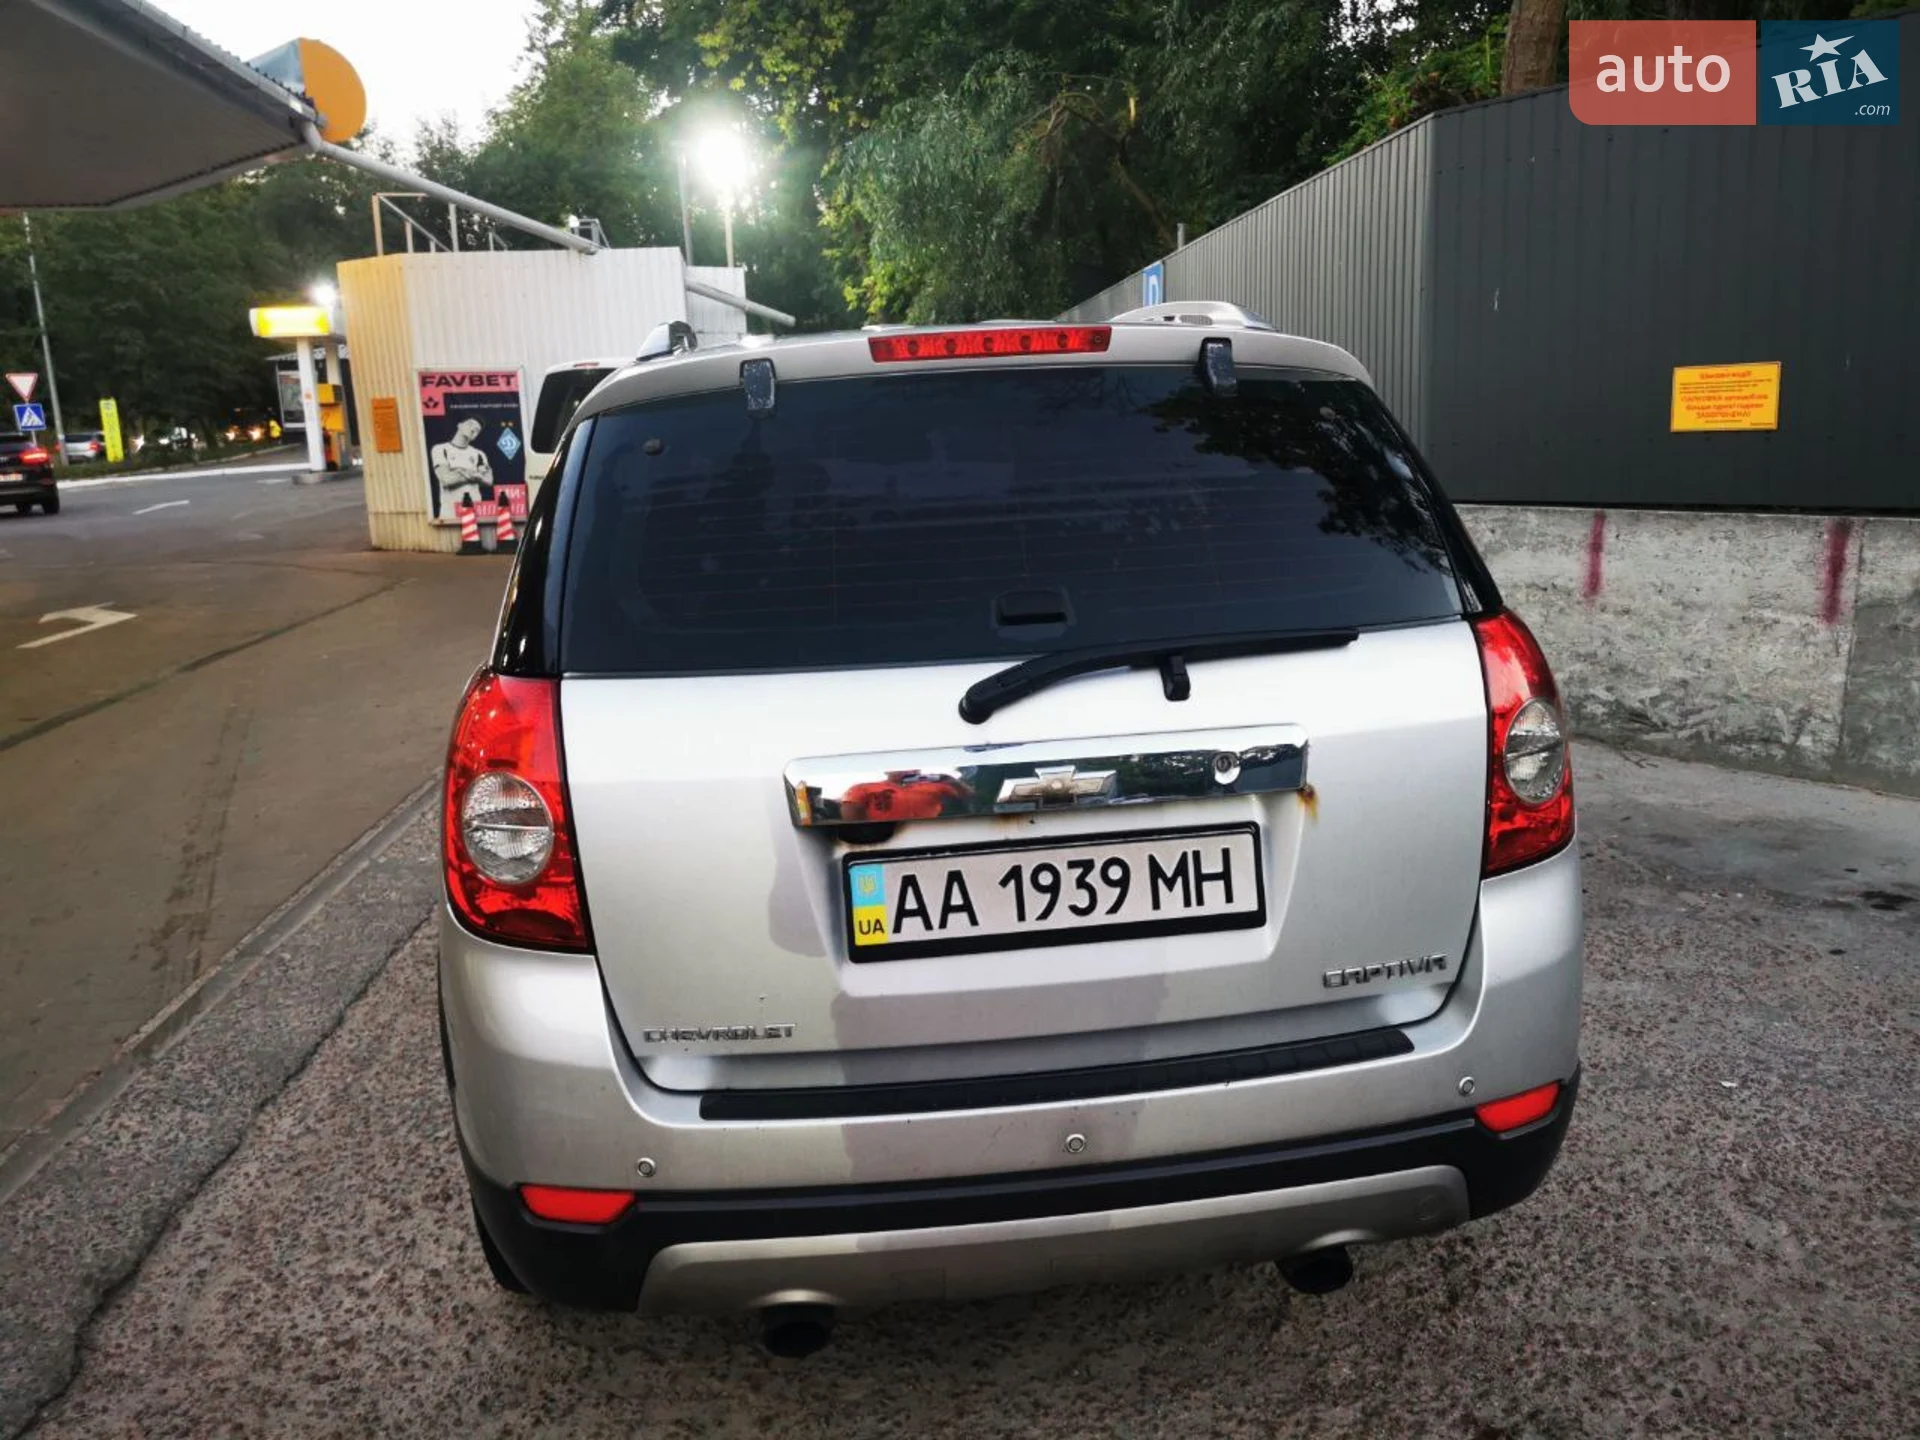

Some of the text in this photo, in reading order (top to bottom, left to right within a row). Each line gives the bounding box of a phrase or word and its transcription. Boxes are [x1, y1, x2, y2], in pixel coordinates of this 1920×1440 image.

[421, 374, 517, 388] FAVBET
[858, 846, 1235, 936] UA AA 1939 MH
[1322, 953, 1448, 988] CAPTIVA
[643, 1023, 797, 1043] CHEVROLET
